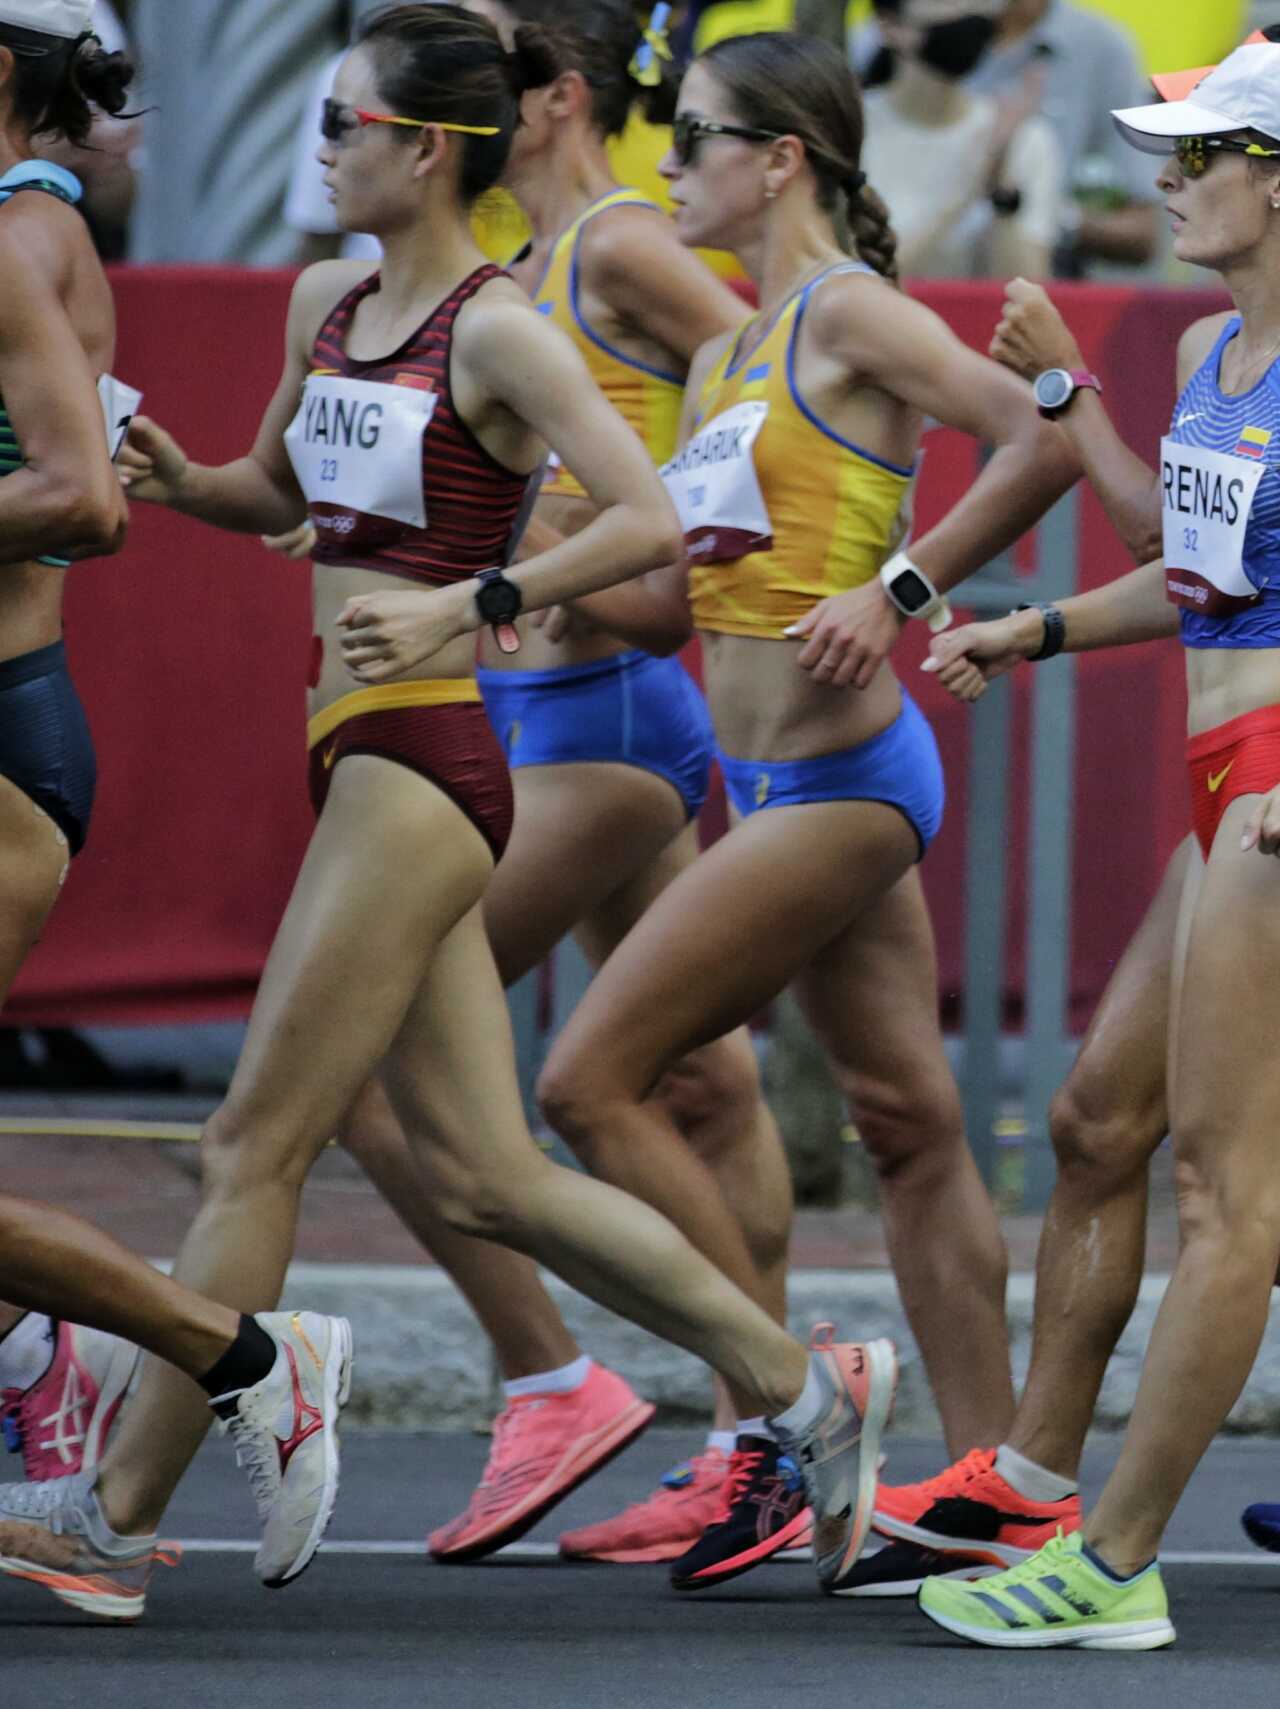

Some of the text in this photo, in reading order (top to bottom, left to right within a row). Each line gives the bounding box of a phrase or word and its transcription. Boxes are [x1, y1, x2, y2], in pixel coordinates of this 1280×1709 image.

[305, 395, 382, 449] YANG
[320, 458, 338, 482] 23
[1183, 527, 1199, 551] 32
